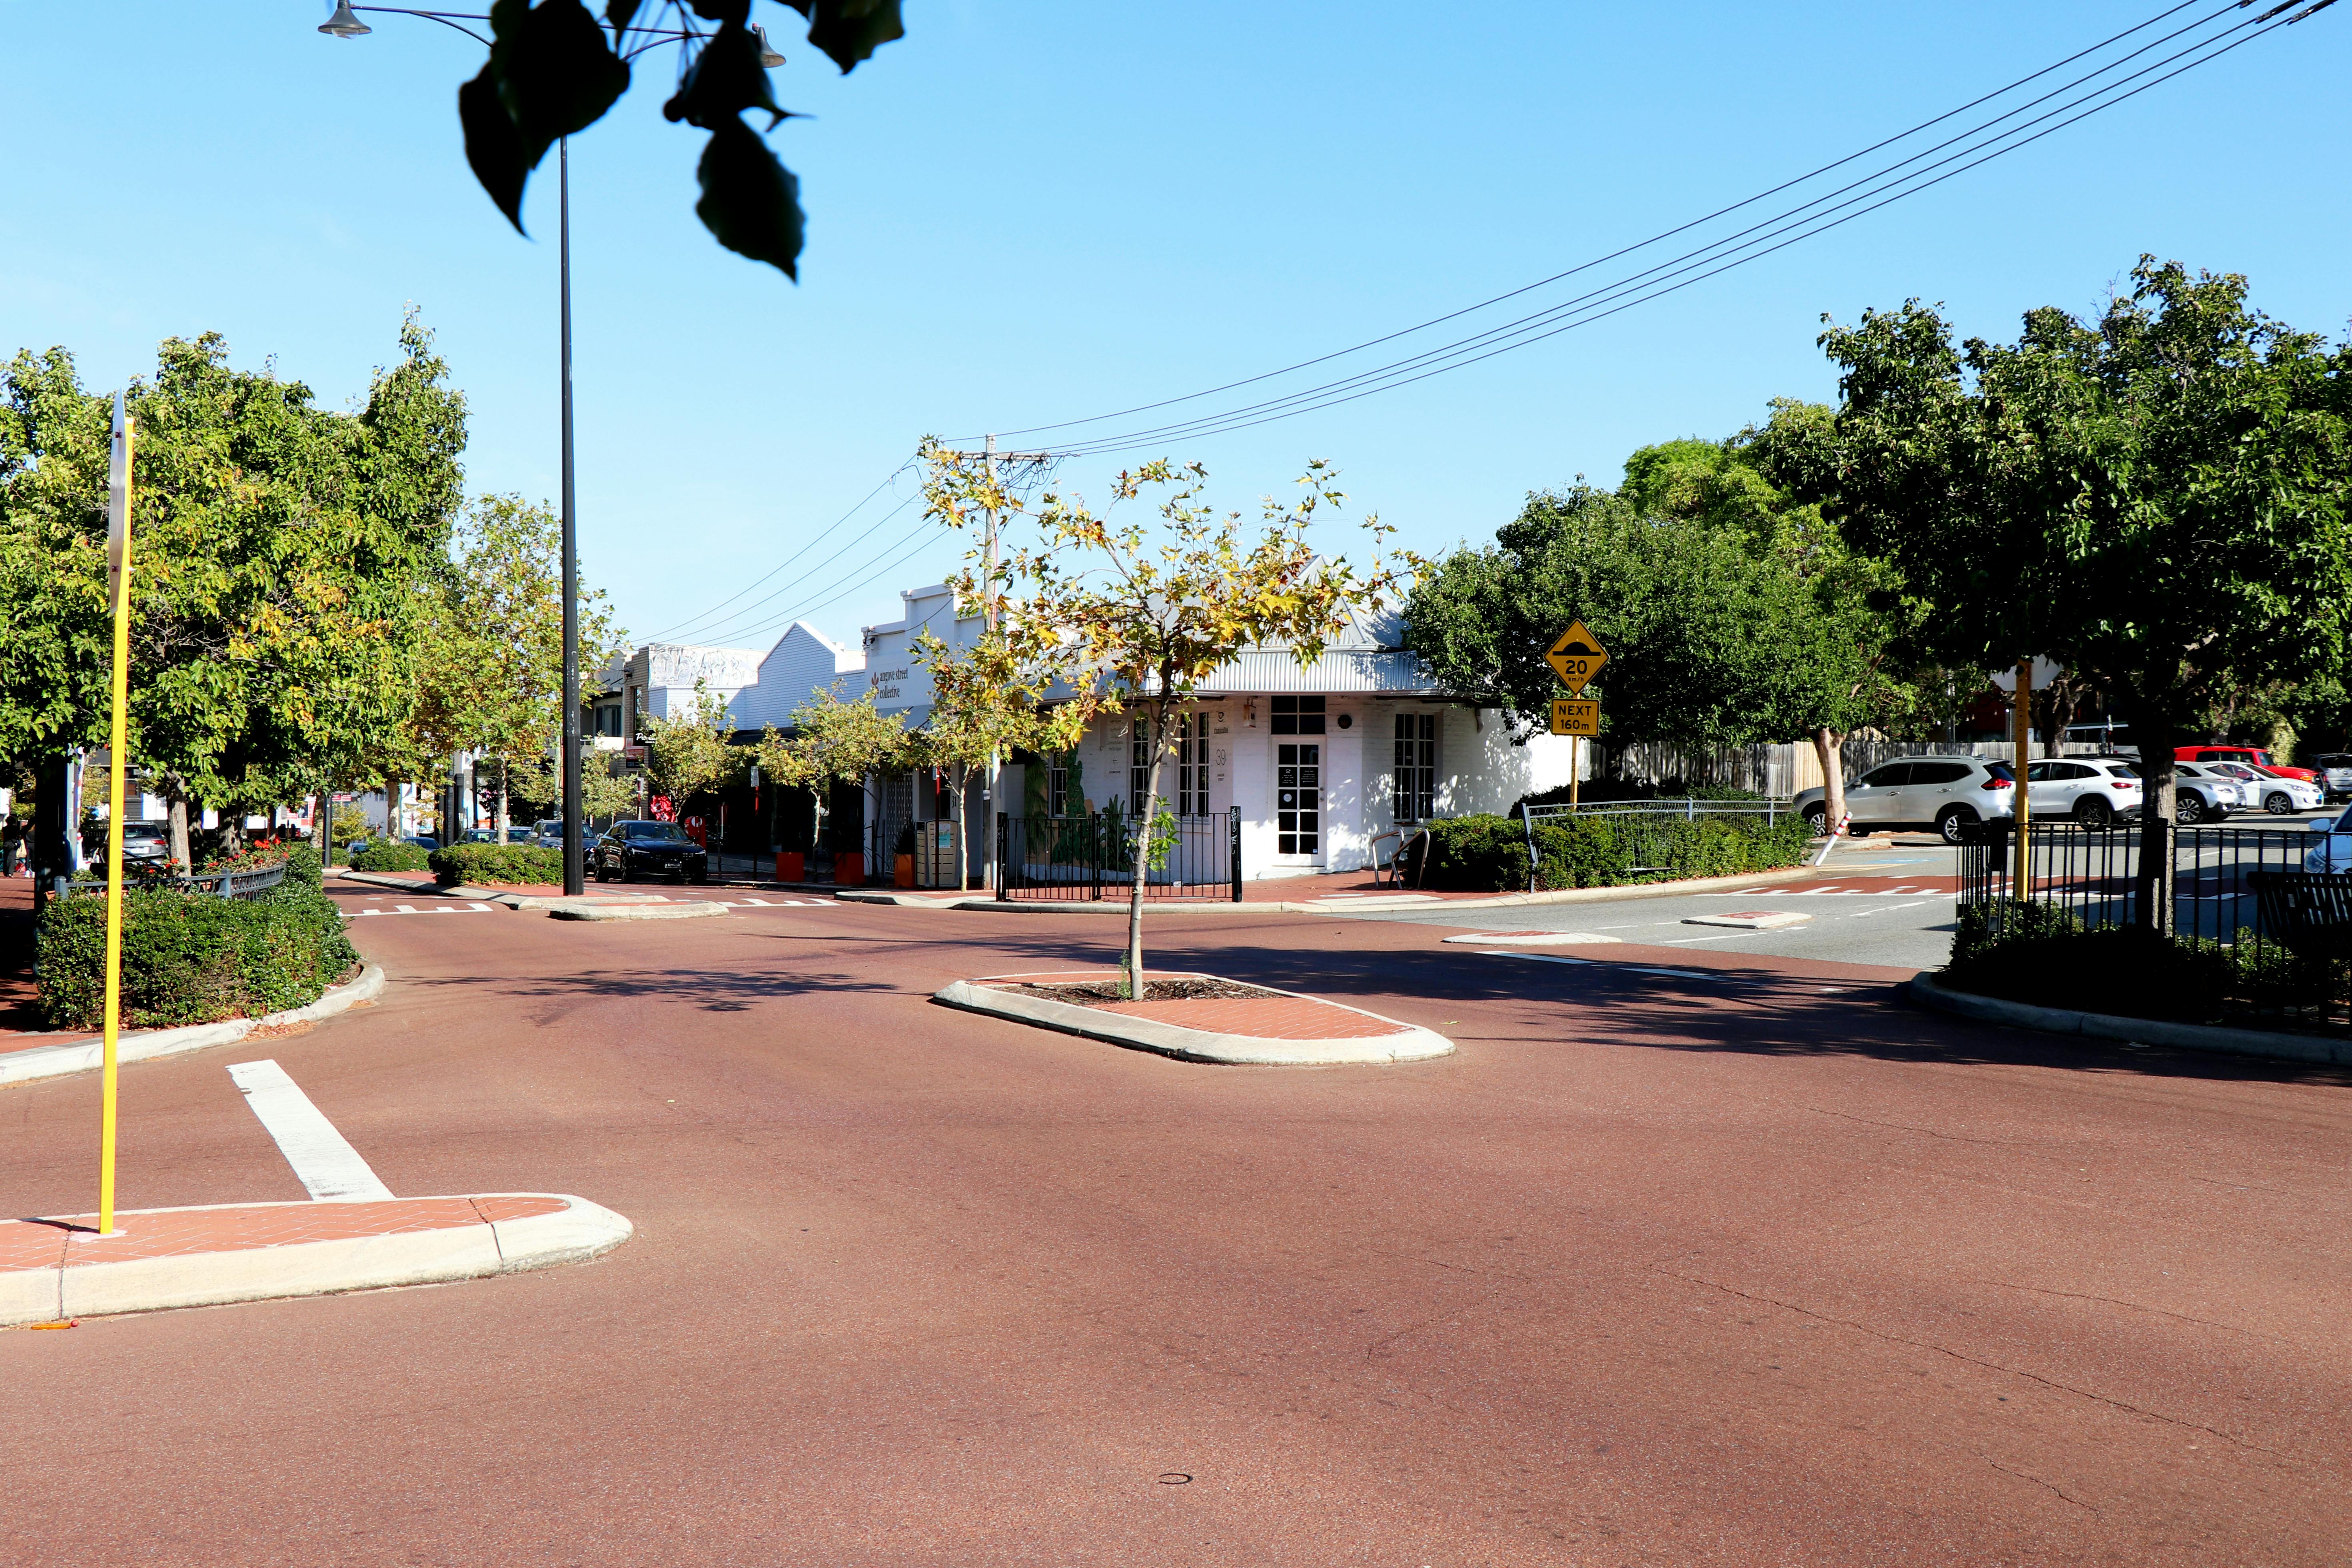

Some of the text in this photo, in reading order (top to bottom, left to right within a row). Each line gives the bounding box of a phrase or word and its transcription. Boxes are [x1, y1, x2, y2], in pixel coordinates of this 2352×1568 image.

[1565, 660, 1587, 675] 20
[880, 667, 908, 684] angove street
[880, 685, 900, 699] collective
[1559, 705, 1591, 716] NEXT
[1216, 749, 1226, 765] 39
[951, 796, 957, 808] 31
